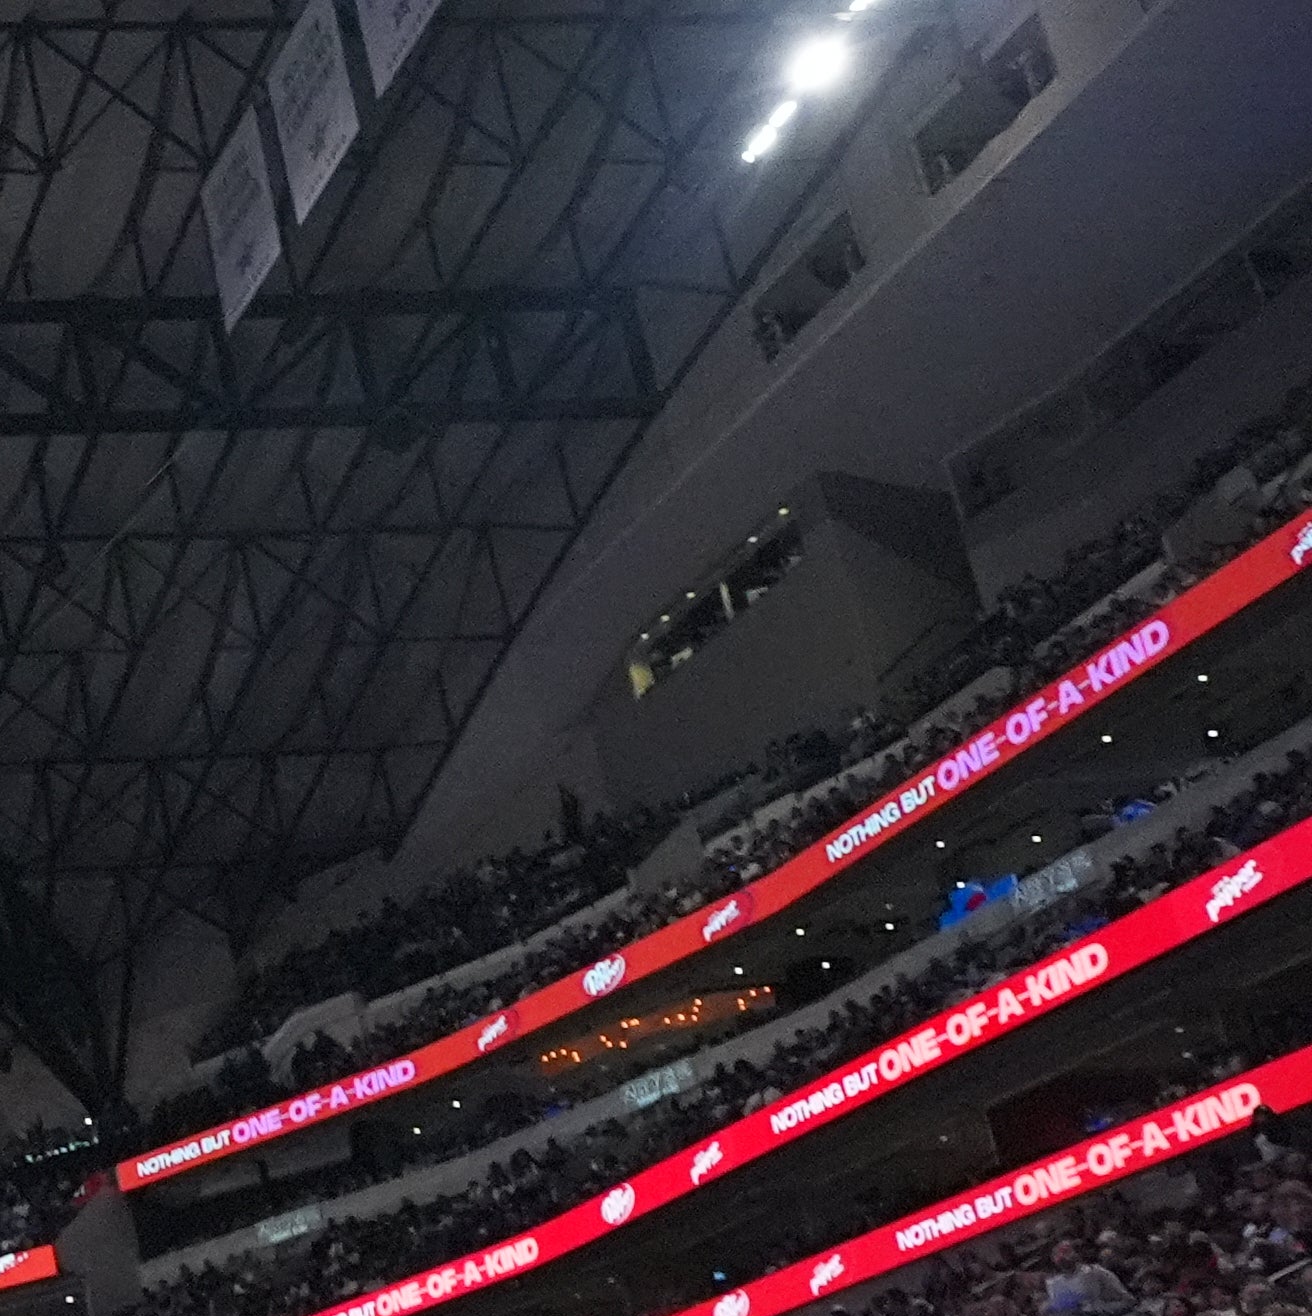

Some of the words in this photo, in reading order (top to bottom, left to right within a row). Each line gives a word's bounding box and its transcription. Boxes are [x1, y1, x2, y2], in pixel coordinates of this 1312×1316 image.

[826, 802, 901, 862] NOTHING
[901, 776, 935, 813] BUT
[938, 621, 1168, 790] ONE-OF-A-KIND
[137, 1142, 200, 1177] NOTHING
[201, 1130, 230, 1153] BUT
[233, 1060, 416, 1143] ONE-OF-A-KIND
[771, 1083, 843, 1134] NOTHING
[844, 1063, 878, 1096] BUT
[879, 944, 1108, 1080] ONE-OF-A-KIND
[896, 1204, 976, 1250] NOTHING
[976, 1187, 1012, 1219] BUT
[1014, 1084, 1260, 1205] ONE-OF-A-KIND
[376, 1238, 538, 1316] ONE-OF-A-KIND
